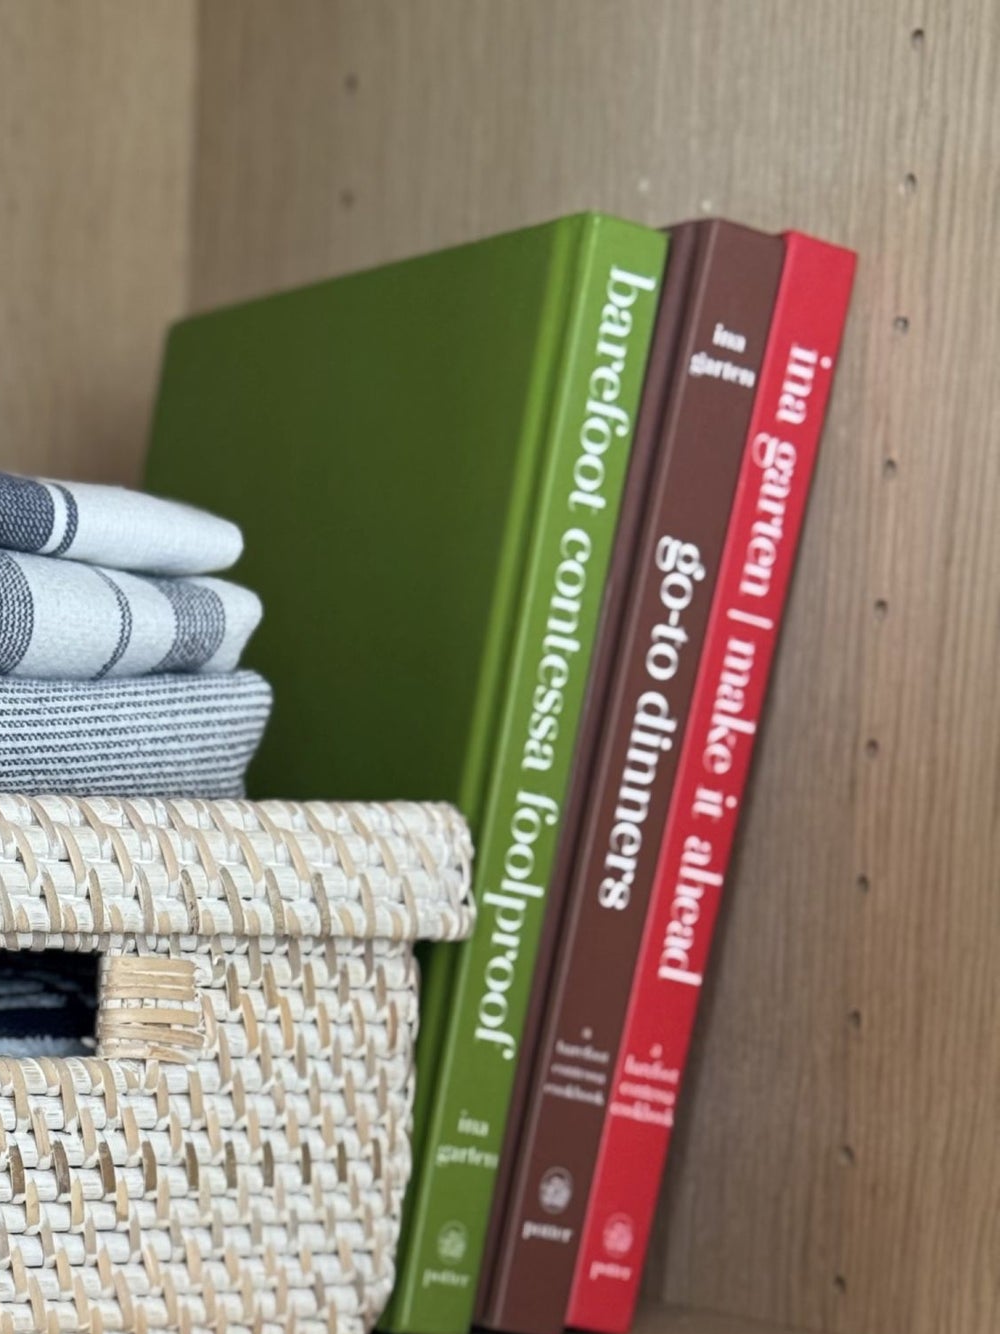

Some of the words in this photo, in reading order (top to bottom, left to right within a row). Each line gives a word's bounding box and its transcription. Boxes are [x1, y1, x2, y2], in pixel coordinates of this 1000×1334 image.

[567, 264, 657, 512] barefoot
[712, 322, 747, 353] ina
[775, 343, 832, 425] ina
[738, 432, 798, 598] garten
[521, 526, 593, 772] contessa
[645, 534, 706, 682] go-to
[702, 637, 756, 775] make
[598, 690, 678, 912] dinners
[691, 786, 738, 820] it
[473, 790, 560, 1061] foolproof
[657, 834, 724, 987] ahead
[457, 1109, 490, 1138] ina
